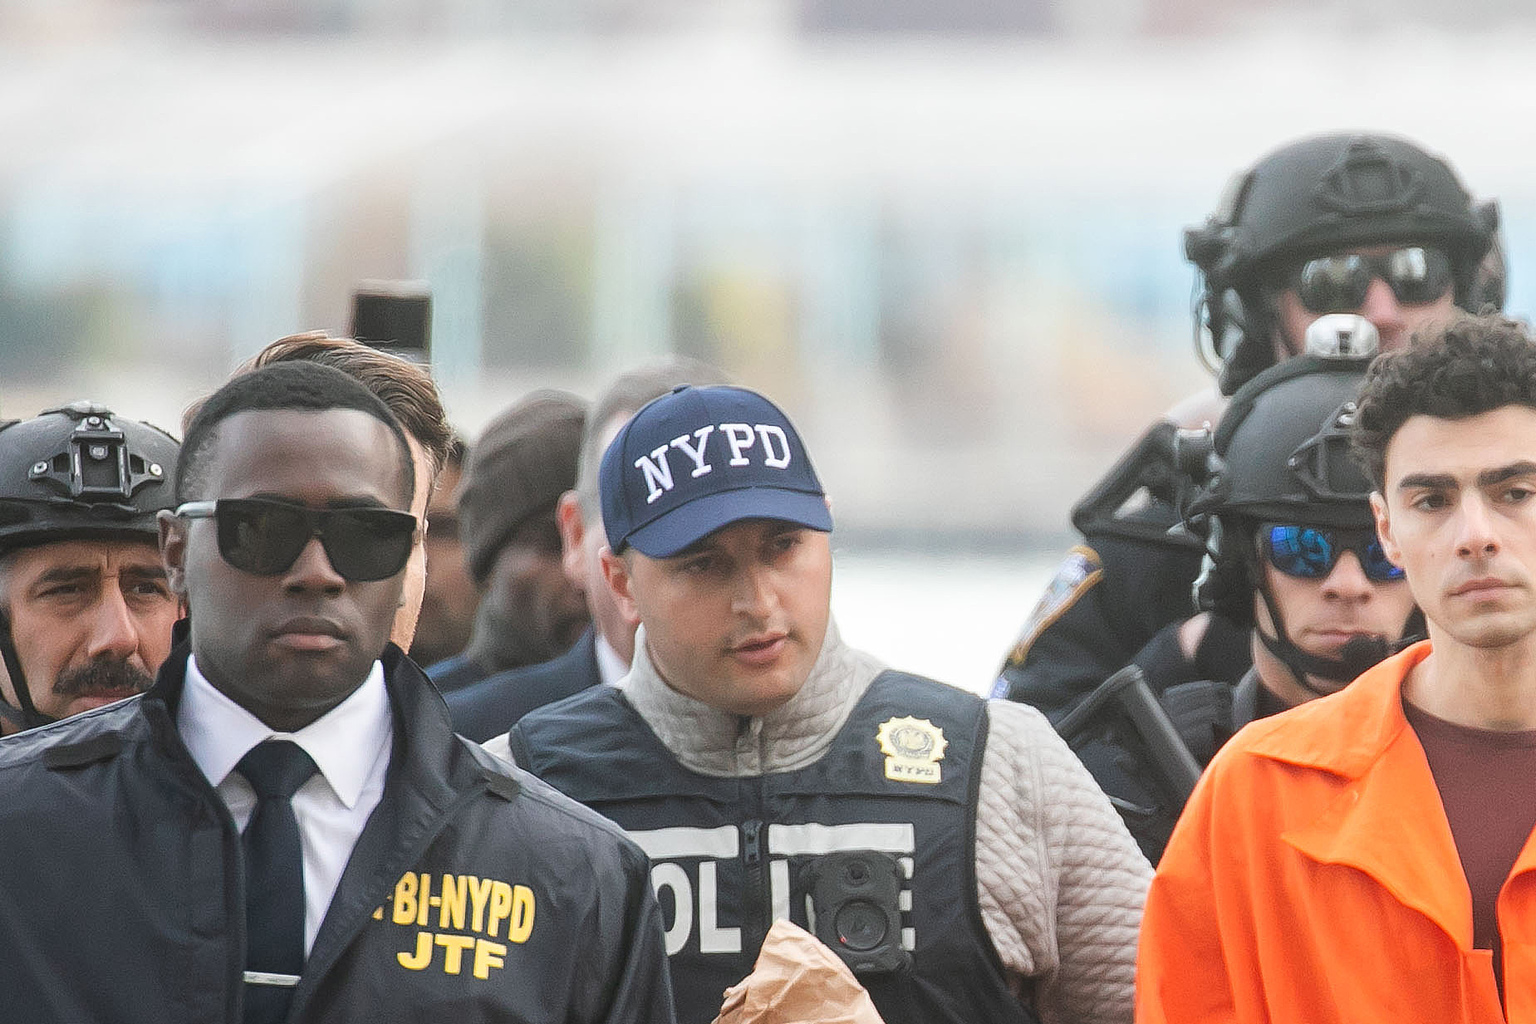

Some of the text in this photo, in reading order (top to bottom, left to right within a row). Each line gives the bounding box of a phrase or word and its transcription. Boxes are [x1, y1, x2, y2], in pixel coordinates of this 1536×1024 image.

[634, 423, 791, 504] NYPD
[372, 871, 536, 943] BI-NYPD
[651, 858, 916, 955] OLI
[397, 931, 508, 980] JTF
